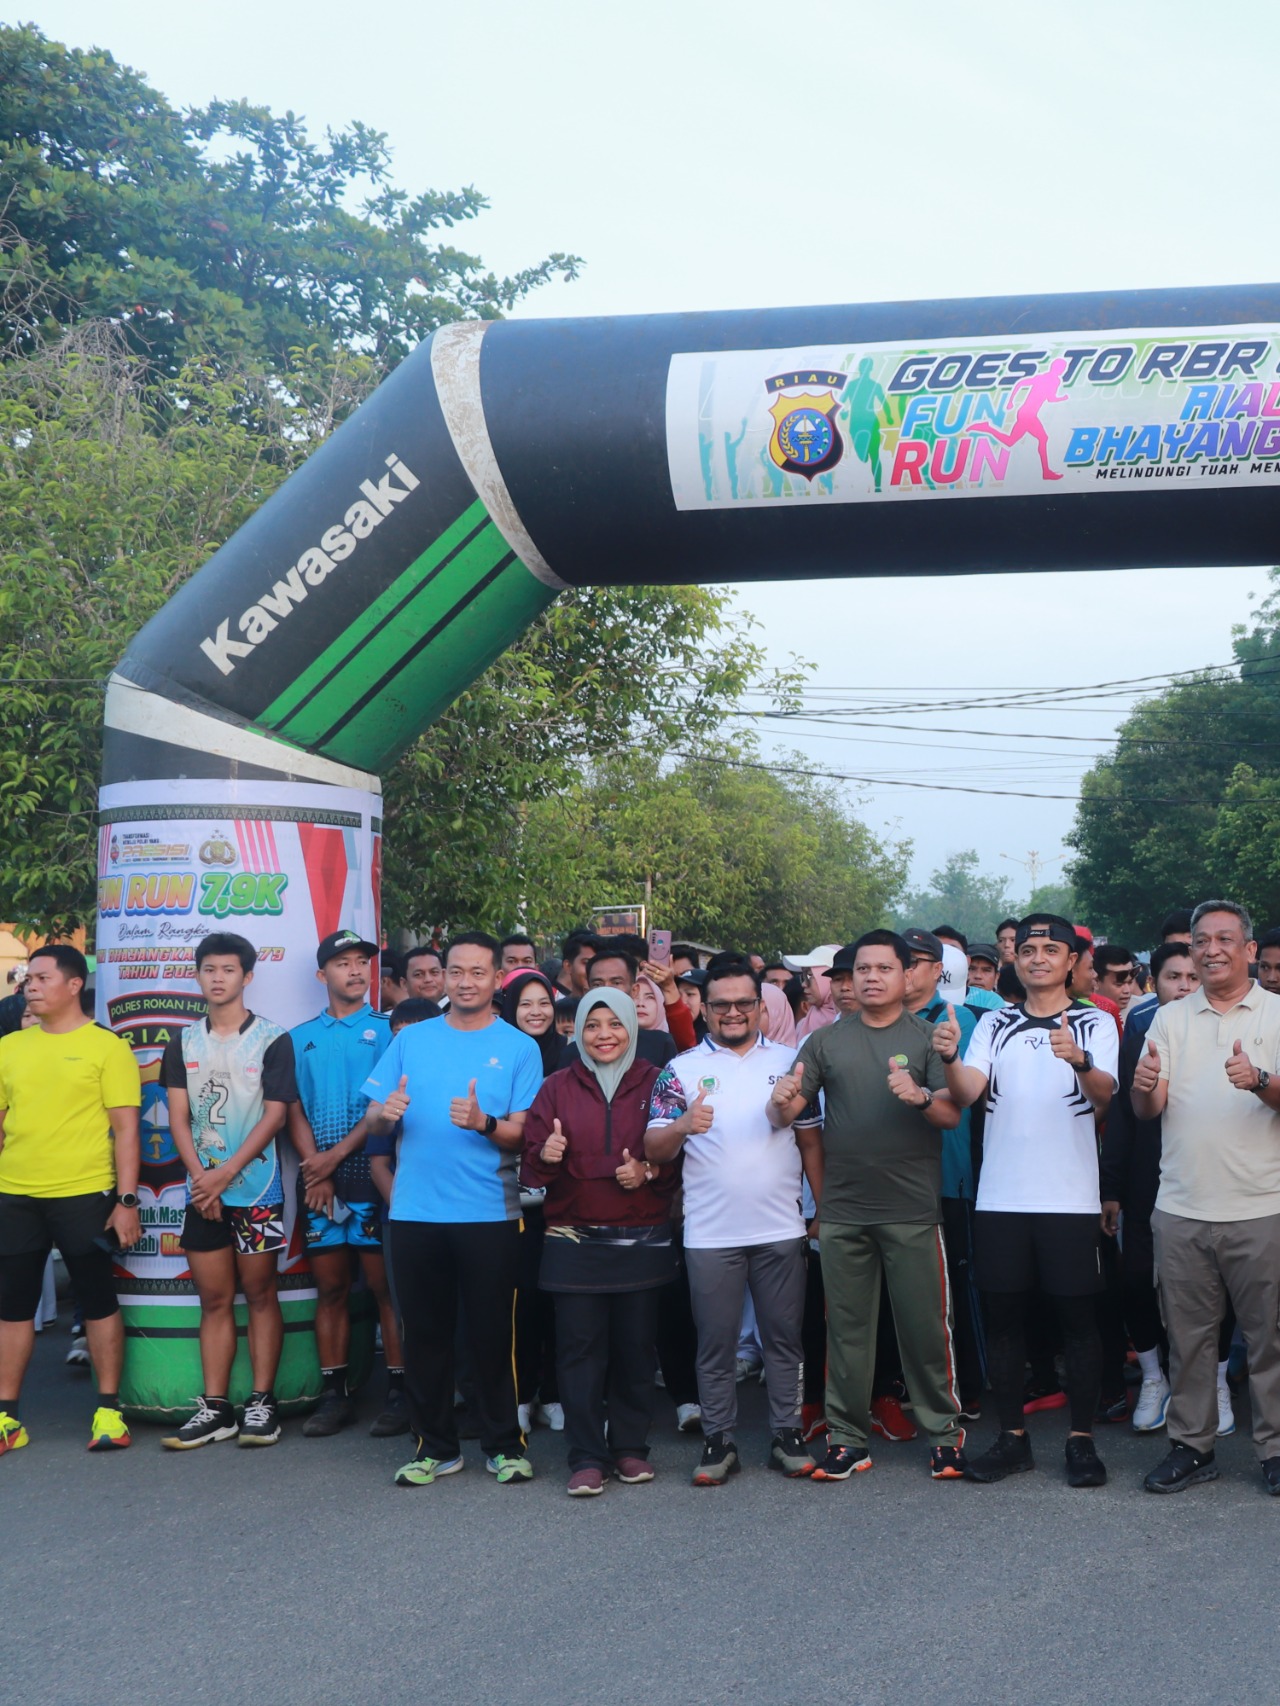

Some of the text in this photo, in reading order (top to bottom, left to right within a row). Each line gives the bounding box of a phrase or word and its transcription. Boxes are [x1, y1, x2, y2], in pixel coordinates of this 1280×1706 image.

[775, 374, 837, 387] RIAU
[887, 351, 1047, 391] GOES
[1063, 347, 1133, 384] TO
[1138, 341, 1268, 379] RBR
[901, 393, 1008, 437] FUN
[890, 438, 1010, 485] RUN
[1096, 466, 1190, 479] MELINDUNGI
[200, 453, 420, 676] Kawasaki
[126, 874, 195, 912] RUN
[200, 873, 286, 914] 7,9K
[118, 923, 154, 940] Dalam
[118, 965, 196, 979] TAHUN 202
[111, 1001, 141, 1017] POLRES
[144, 999, 183, 1010] ROKAN
[122, 1028, 171, 1045] RIA
[209, 1085, 228, 1125] 2
